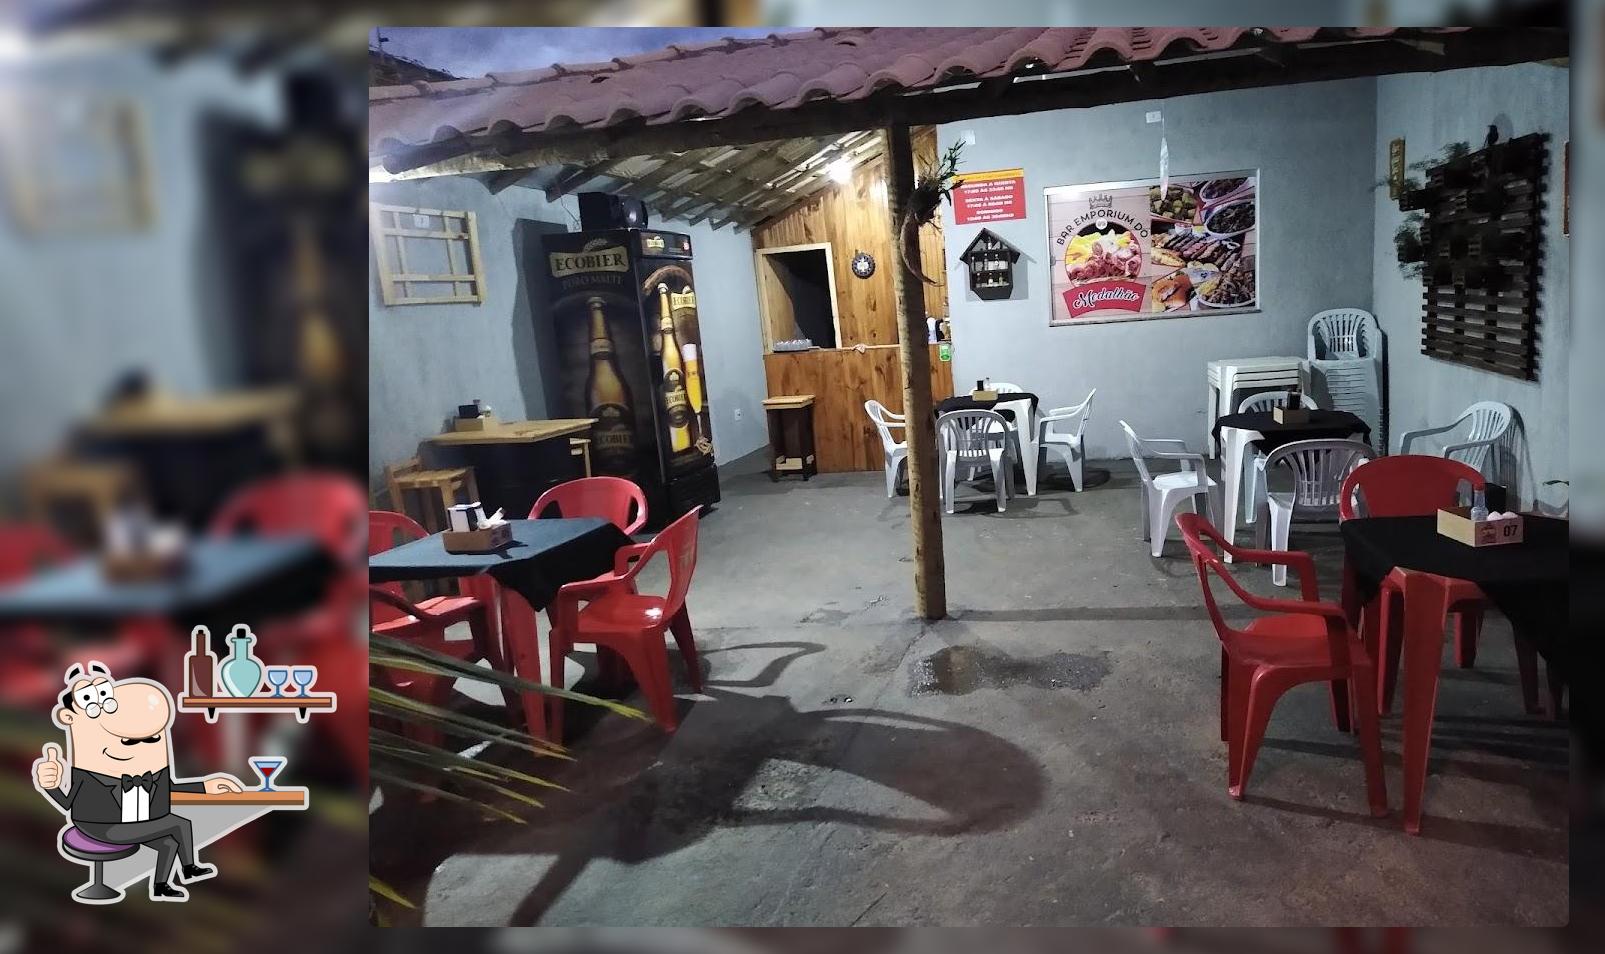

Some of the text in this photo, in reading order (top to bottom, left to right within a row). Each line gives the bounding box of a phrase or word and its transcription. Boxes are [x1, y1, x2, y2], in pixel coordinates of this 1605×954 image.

[1056, 209, 1149, 246] BAR EMPORIUM DO
[555, 253, 626, 271] ECOBIER
[1072, 286, 1140, 309] Medalhão
[1504, 525, 1518, 536] 07
